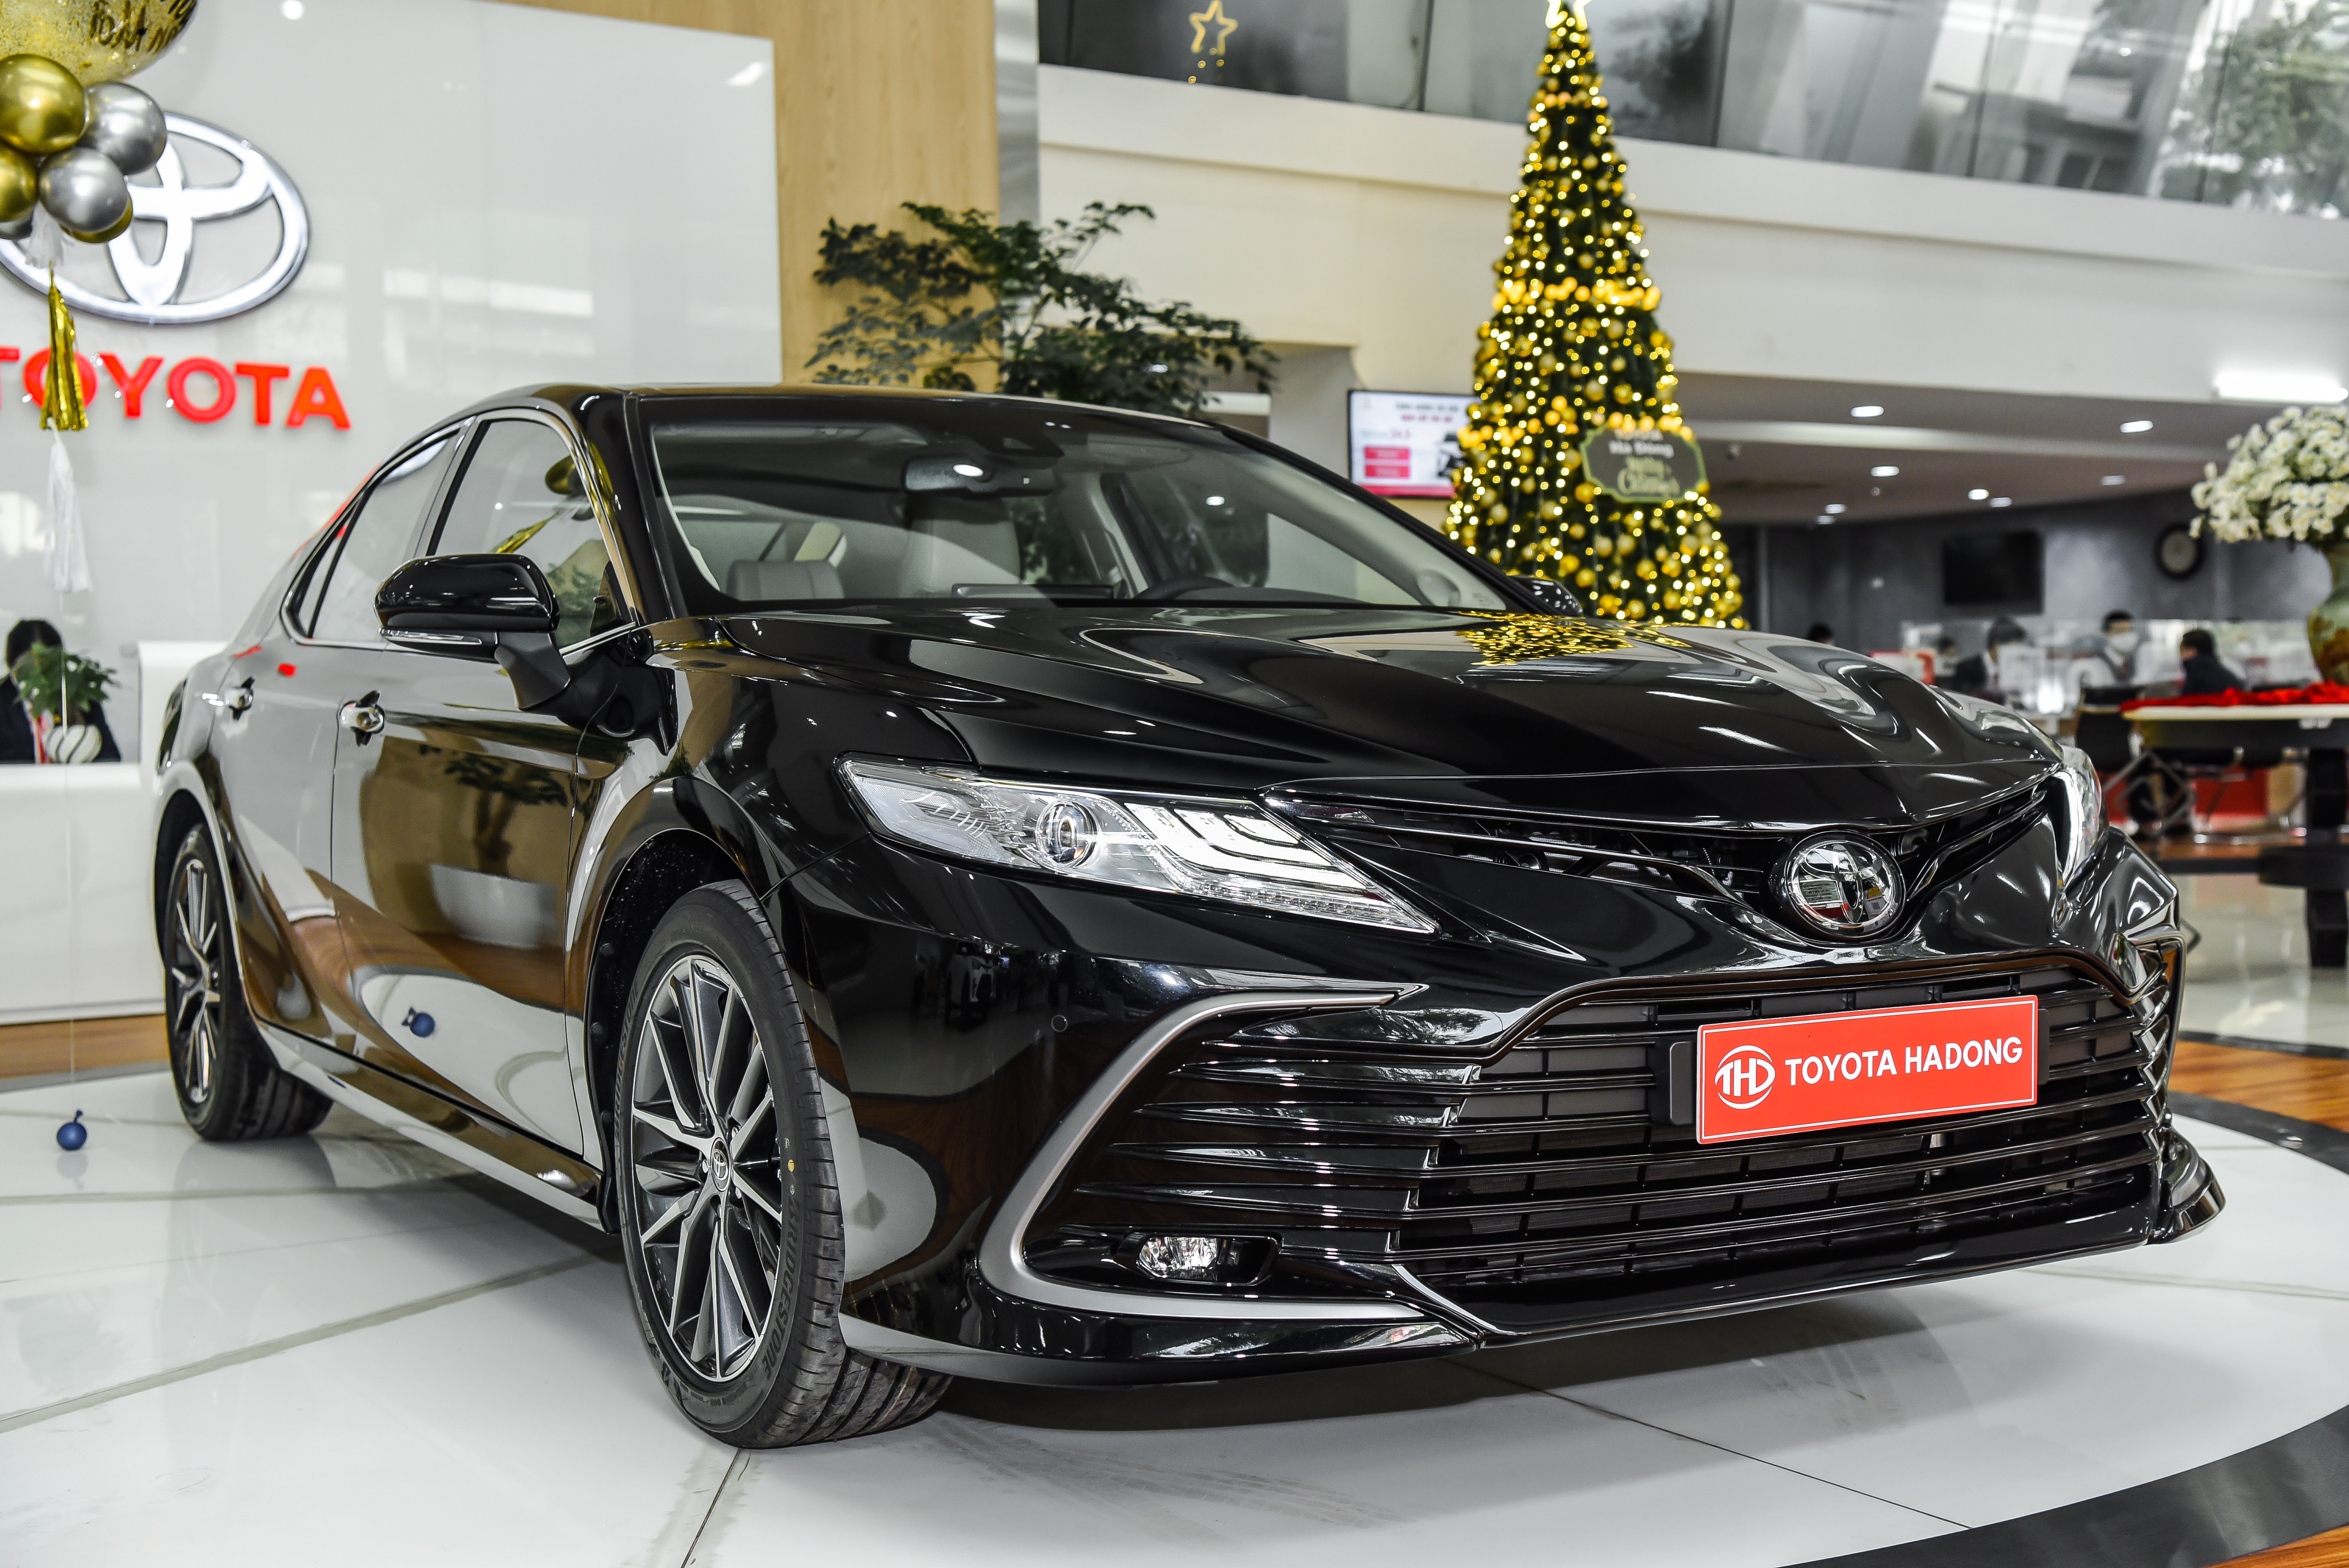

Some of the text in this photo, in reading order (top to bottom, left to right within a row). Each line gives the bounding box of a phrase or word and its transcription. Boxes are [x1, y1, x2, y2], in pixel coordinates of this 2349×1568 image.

[0, 346, 351, 430] OYOTA
[1785, 1037, 2023, 1086] TOYOTA HADONG
[762, 1196, 801, 1380] BRIDGESTONE
